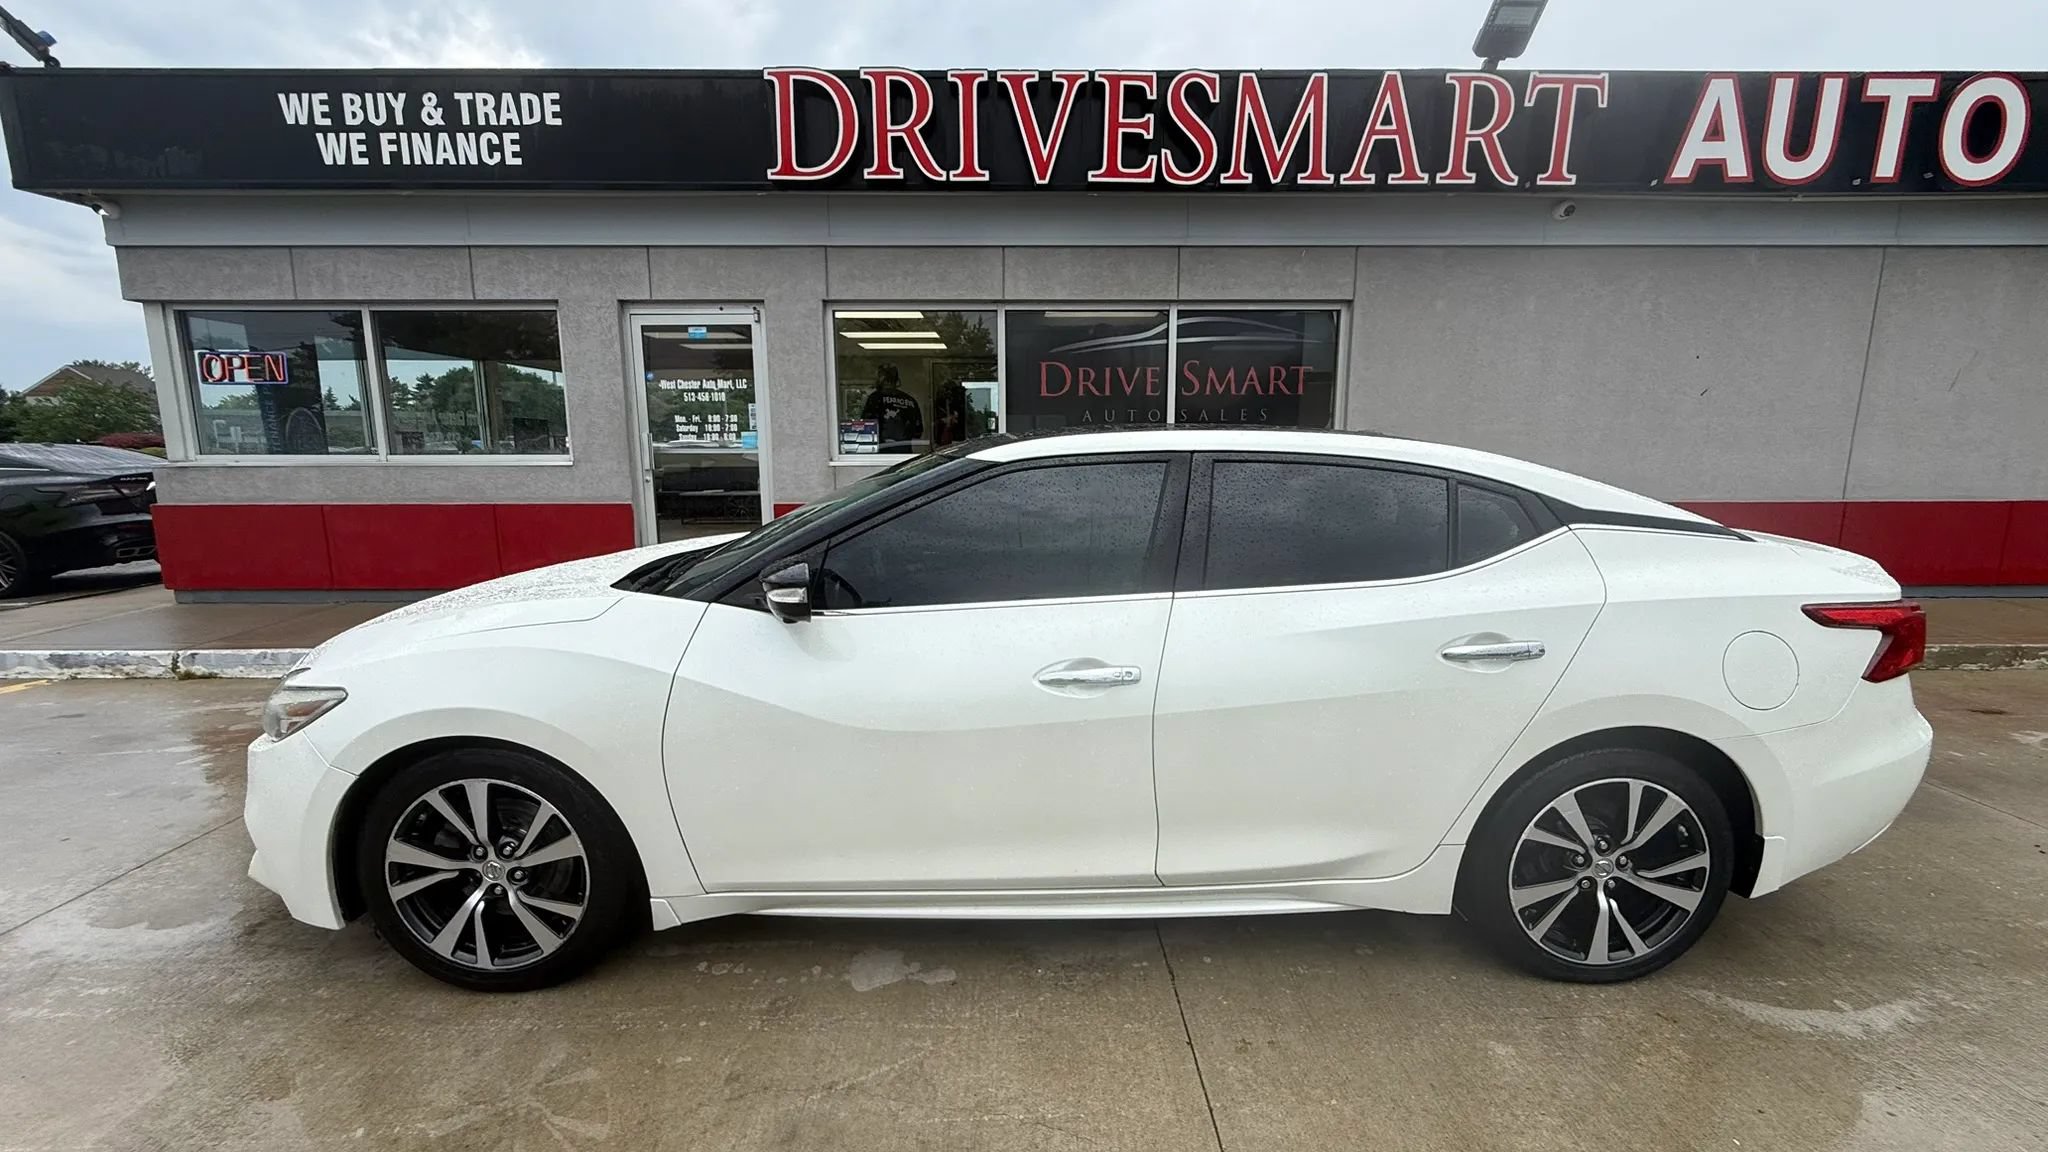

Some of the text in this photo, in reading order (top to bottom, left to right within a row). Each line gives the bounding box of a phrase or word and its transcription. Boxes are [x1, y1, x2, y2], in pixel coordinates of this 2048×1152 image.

[277, 91, 563, 127] WE BUY & TRADE
[763, 66, 2032, 188] DRIVESMART AUTO
[315, 132, 523, 166] WE FINANCE
[202, 353, 285, 383] OPEN
[677, 379, 701, 390] Chester
[736, 378, 748, 389] LLC
[1038, 360, 1313, 397] DRIVE SMART
[1082, 408, 1268, 423] AUTO SALES
